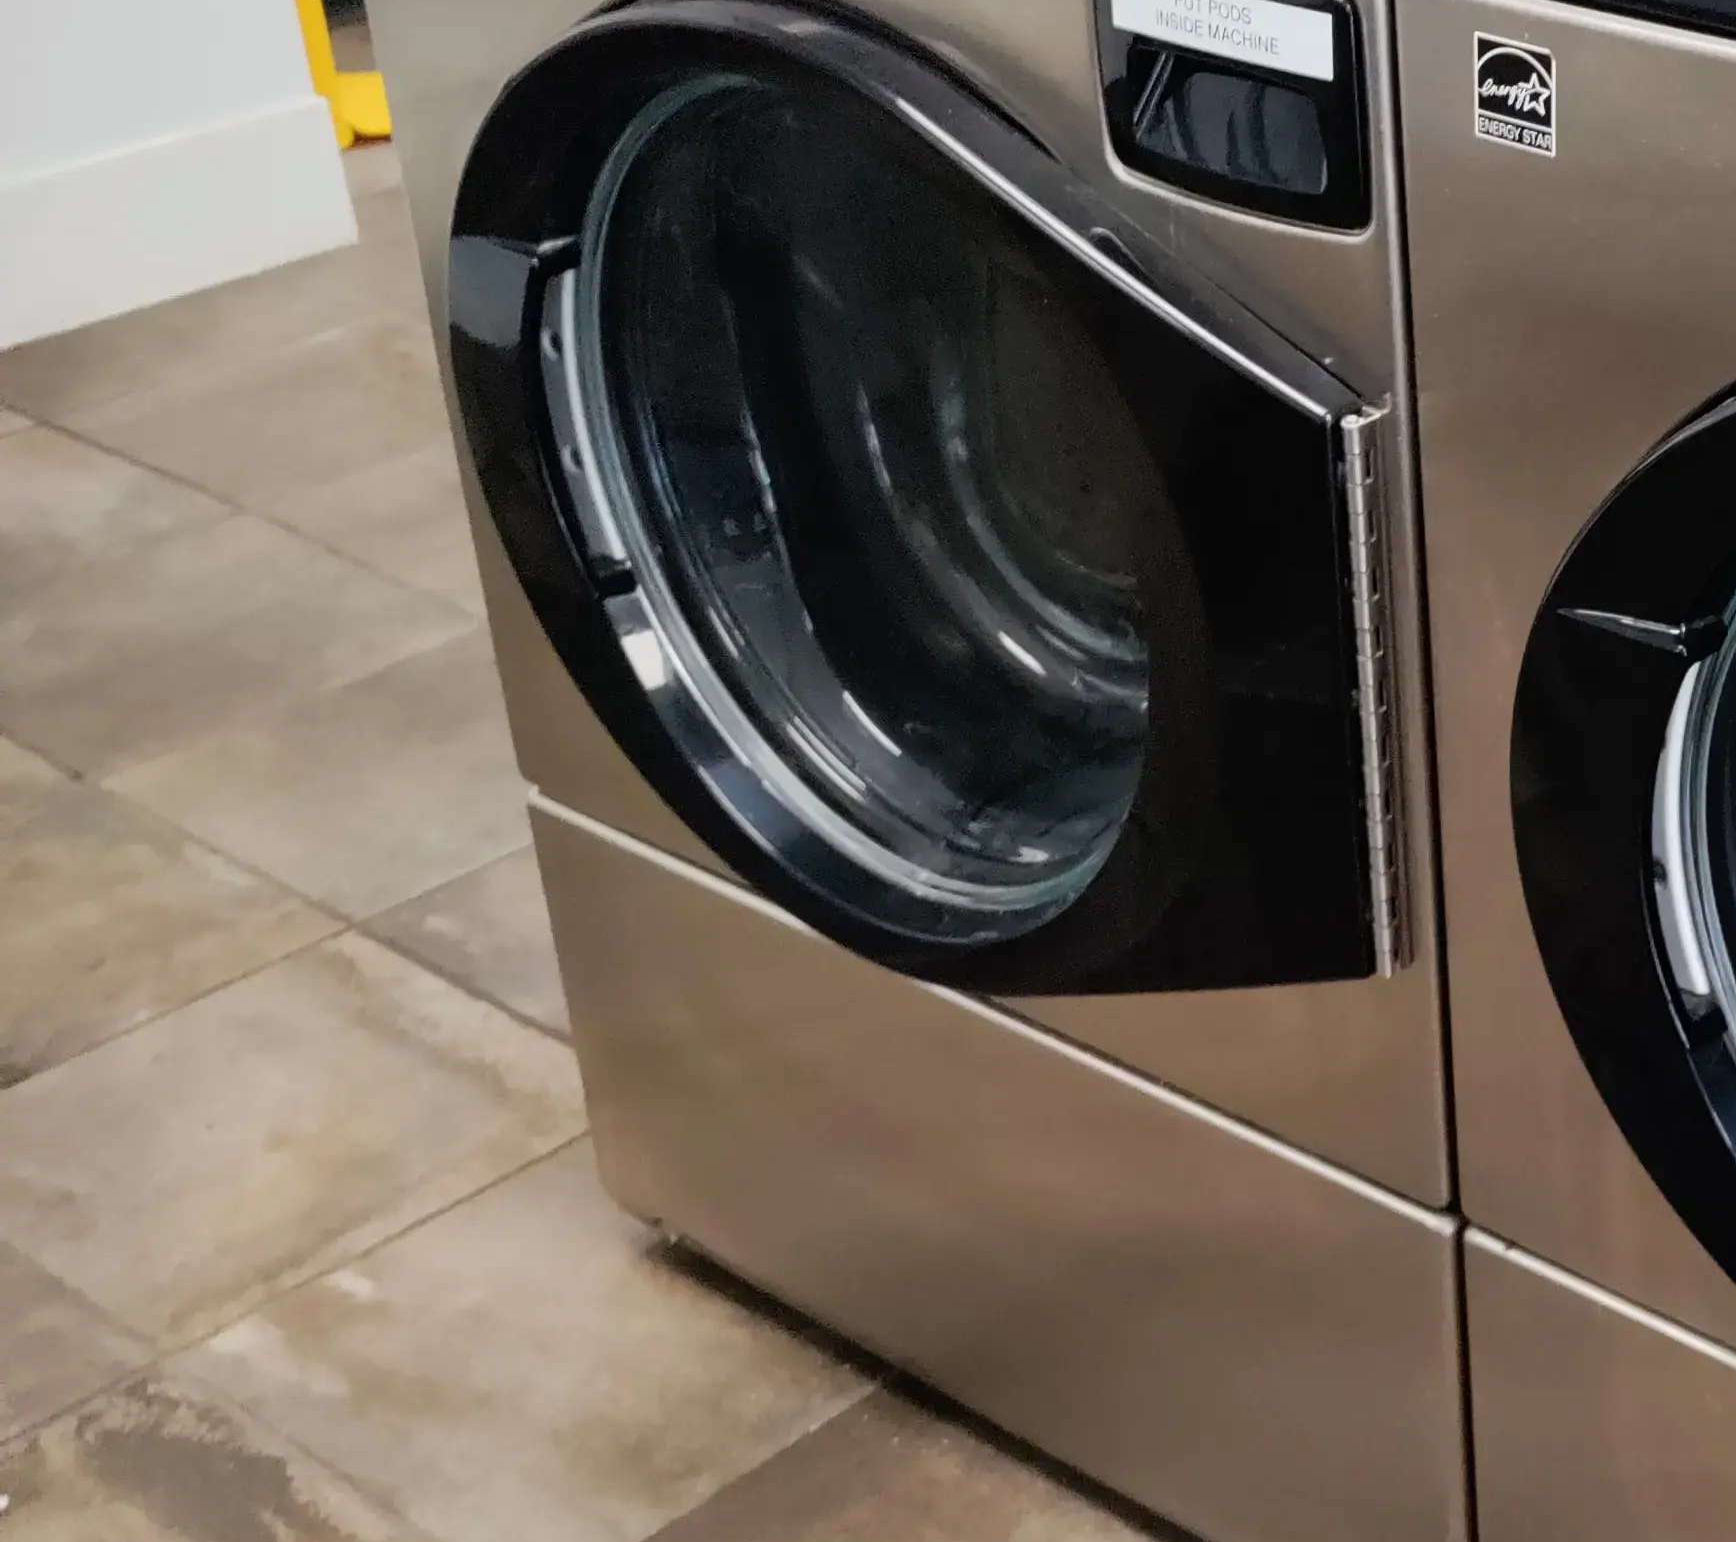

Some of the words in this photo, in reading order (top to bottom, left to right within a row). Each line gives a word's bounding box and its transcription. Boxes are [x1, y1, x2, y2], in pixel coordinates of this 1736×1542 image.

[1156, 6, 1204, 38] INSIDE
[1208, 22, 1280, 55] MACHINE
[1479, 116, 1522, 142] ENERGY
[1522, 131, 1553, 150] STAR
